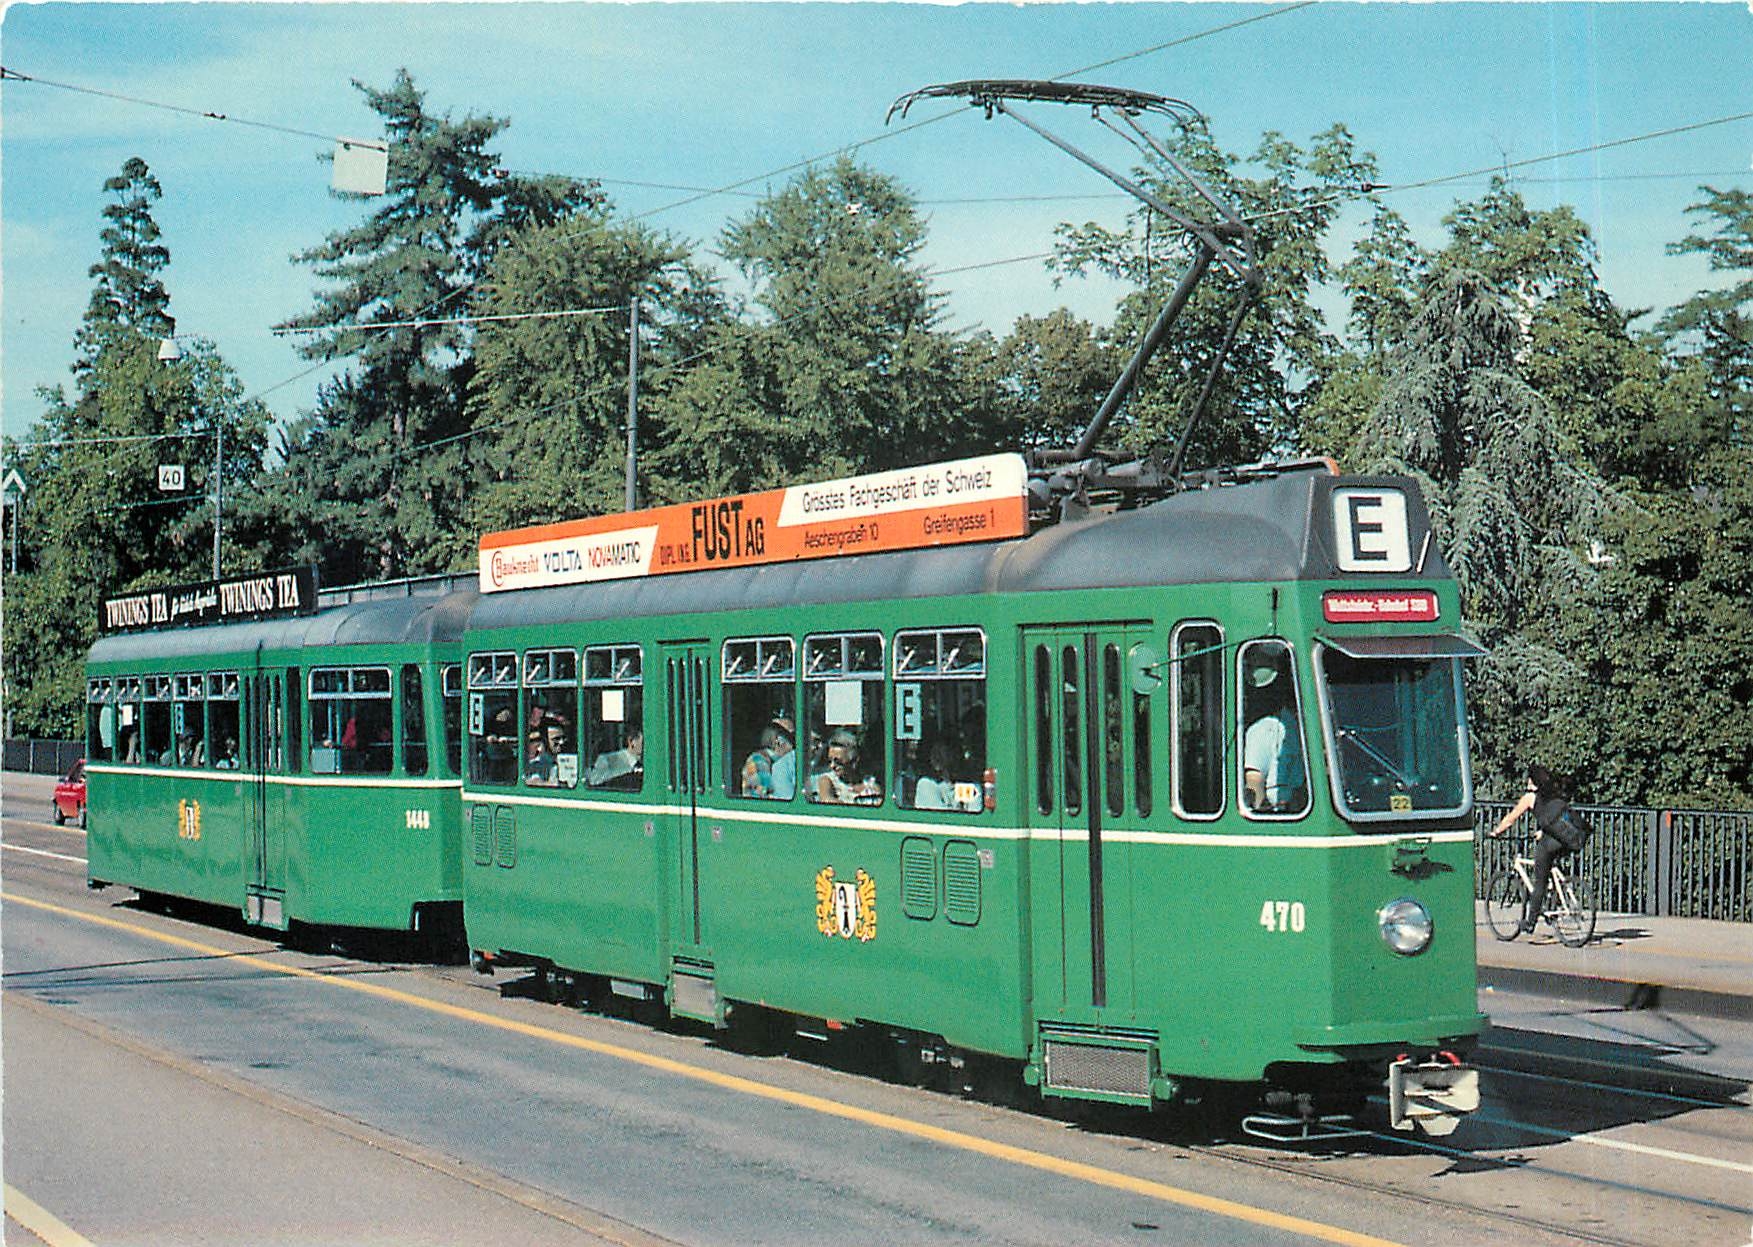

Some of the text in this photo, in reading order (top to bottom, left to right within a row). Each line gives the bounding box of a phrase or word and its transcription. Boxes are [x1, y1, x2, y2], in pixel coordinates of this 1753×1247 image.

[162, 470, 181, 485] 40
[802, 465, 992, 513] Grösstes Fachgeschäft der Schweiz
[692, 500, 743, 562] FUST
[745, 517, 765, 557] AG
[804, 523, 879, 549] Aeschengraben 10
[923, 508, 995, 537] Greifengasse 1
[1348, 497, 1388, 560] E
[544, 550, 582, 573] VOLTA
[588, 541, 641, 567] NOVAMATIC
[105, 596, 149, 628] TWININGS
[150, 593, 168, 623] TEA
[219, 577, 274, 615] TWININGS
[276, 574, 300, 609] TEA
[903, 689, 914, 734] E
[1259, 900, 1305, 932] 470
